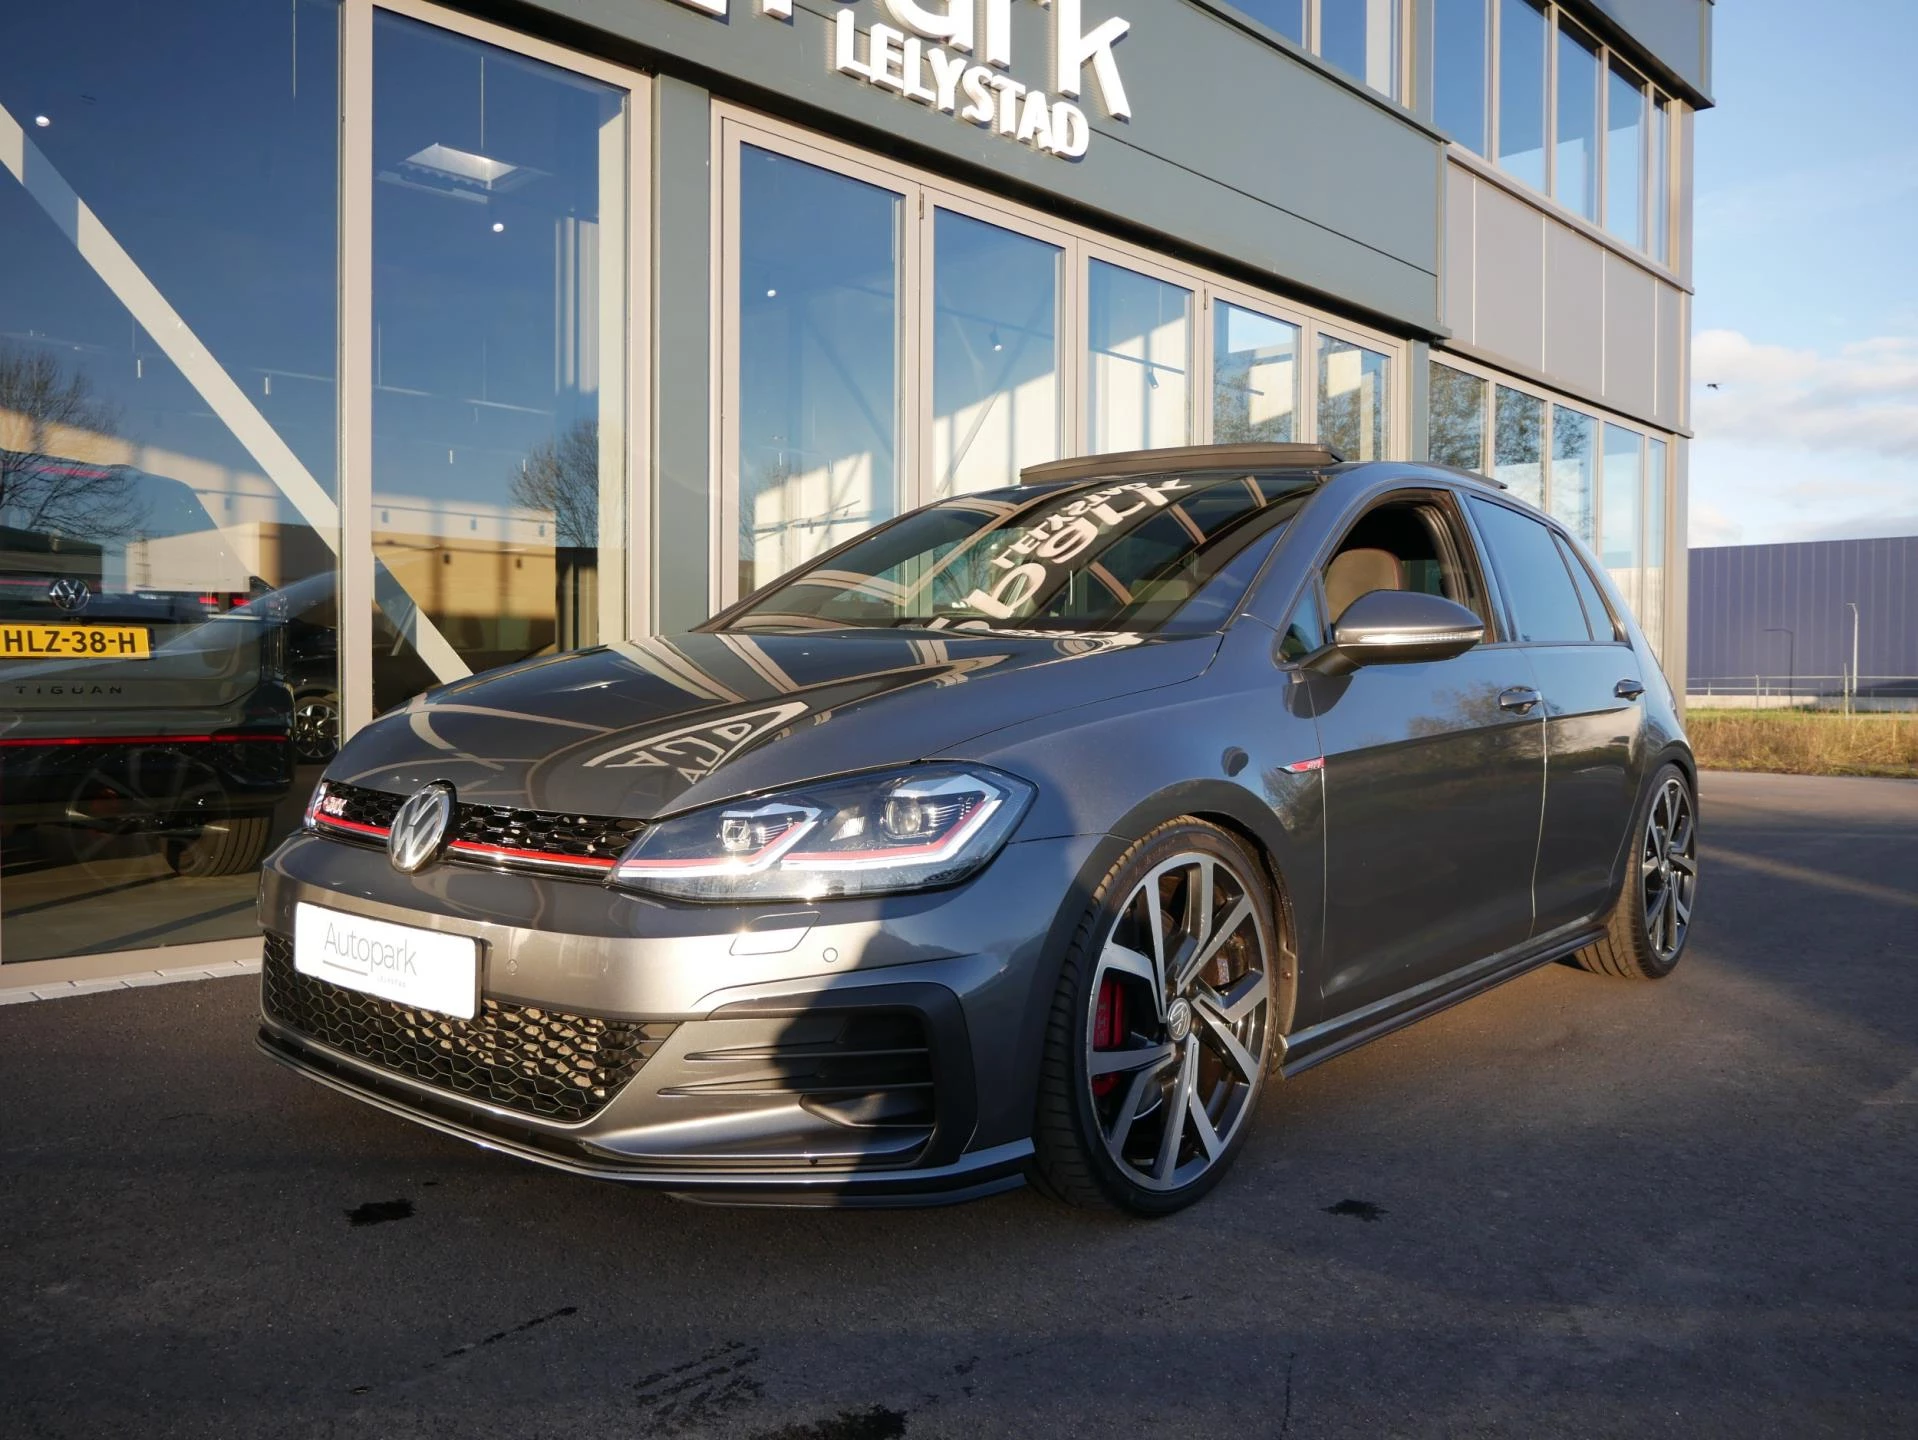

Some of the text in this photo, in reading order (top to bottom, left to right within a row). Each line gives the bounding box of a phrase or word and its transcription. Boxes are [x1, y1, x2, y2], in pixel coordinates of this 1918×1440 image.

[835, 8, 1090, 159] LELYSTAD
[3, 629, 137, 654] HLZ-38-H
[15, 685, 123, 695] TIGUAN
[323, 921, 418, 976] Autopark
